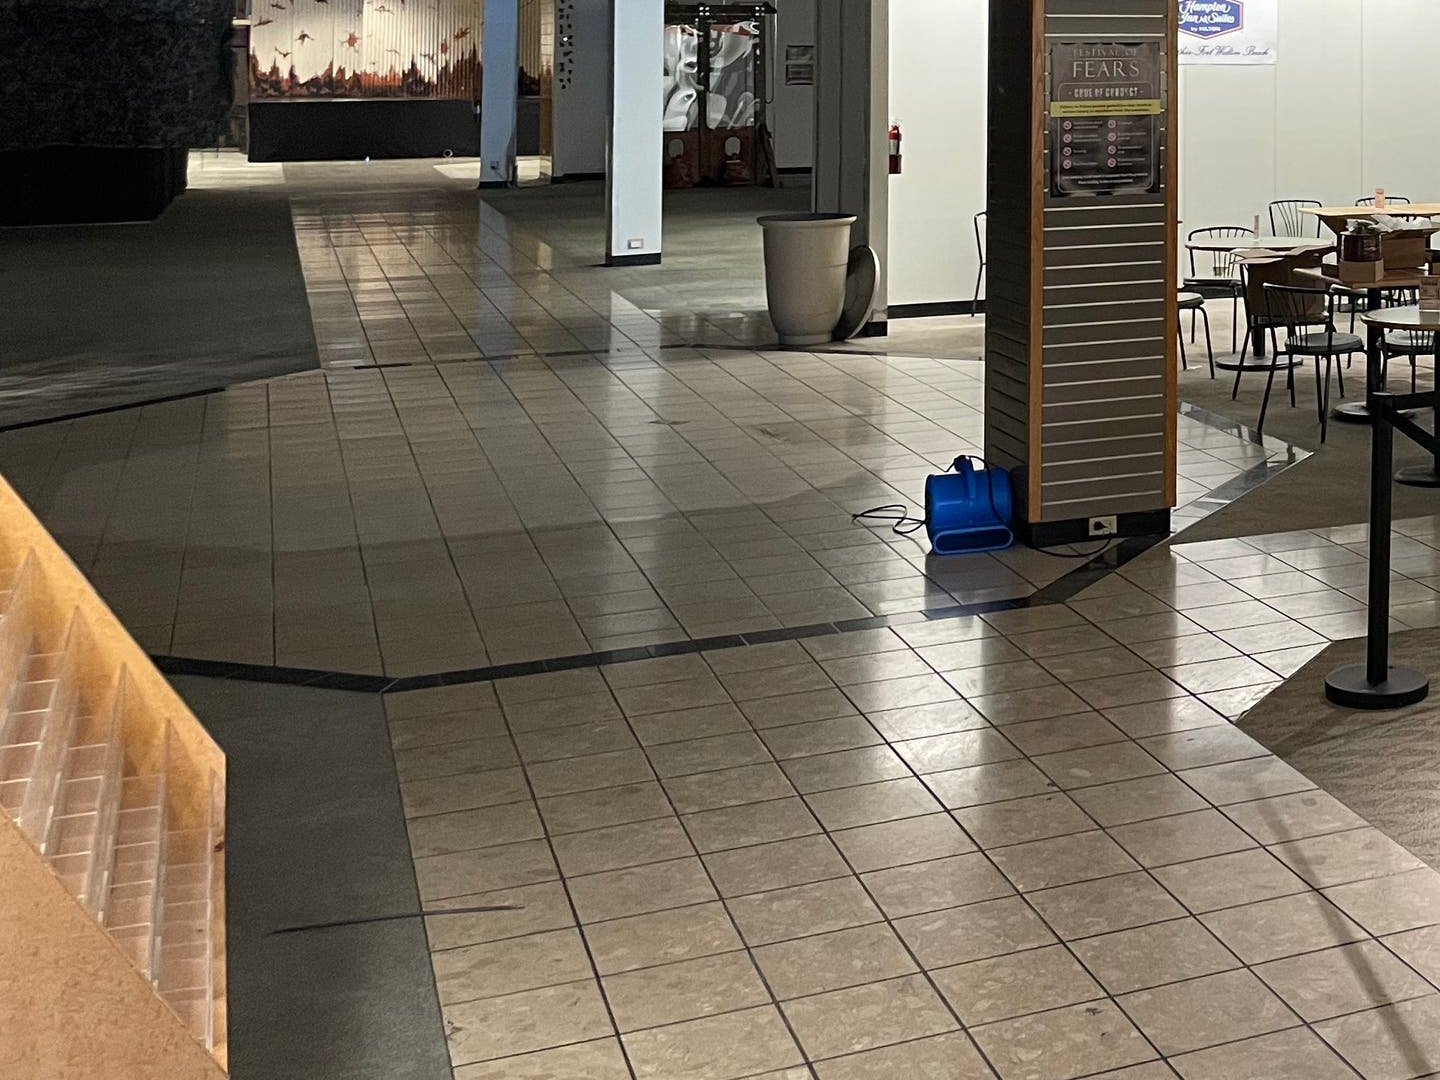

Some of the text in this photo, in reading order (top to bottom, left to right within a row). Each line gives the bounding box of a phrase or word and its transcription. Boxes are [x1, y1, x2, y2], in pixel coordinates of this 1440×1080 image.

[1179, 0, 1231, 13] Hampton
[1178, 13, 1200, 24] Inn
[1208, 12, 1235, 24] Suites
[1072, 60, 1140, 78] FEARS
